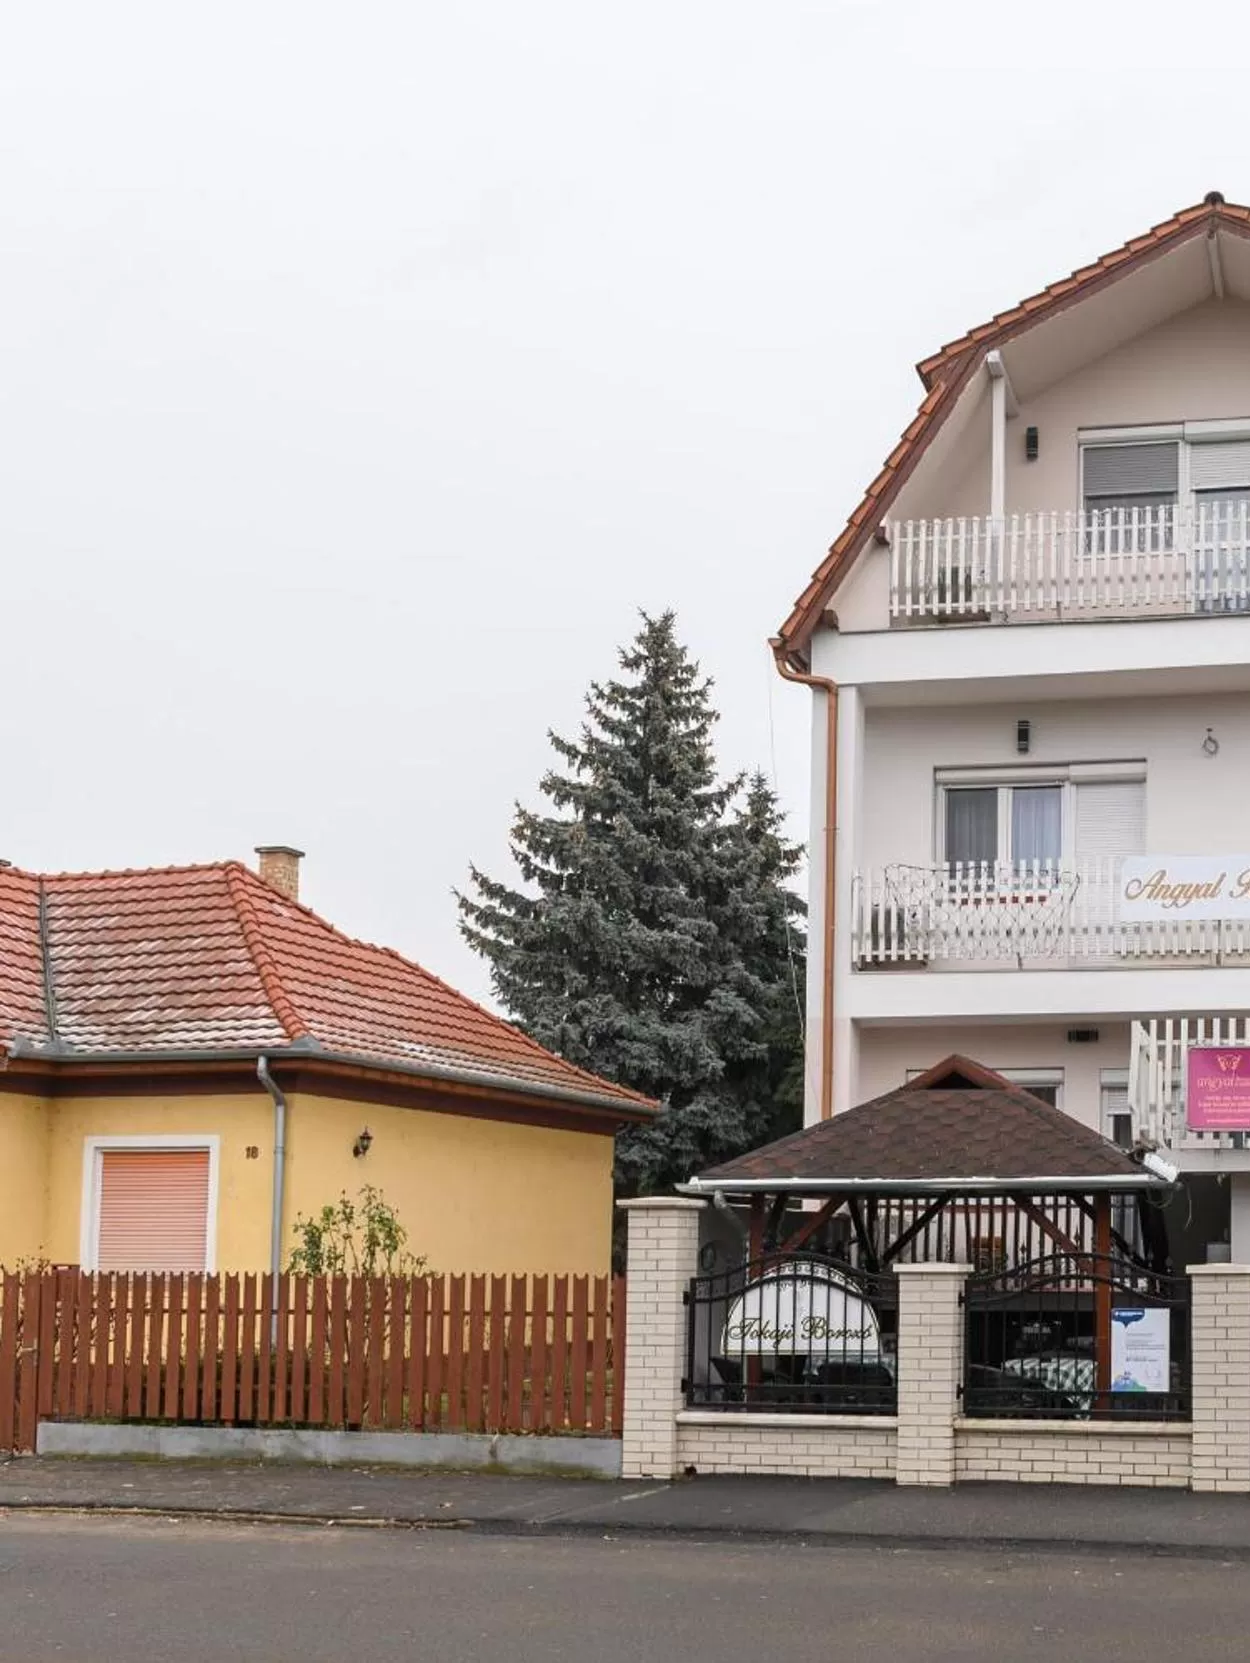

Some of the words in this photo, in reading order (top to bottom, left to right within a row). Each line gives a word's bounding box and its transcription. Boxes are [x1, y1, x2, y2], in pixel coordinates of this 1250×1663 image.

[1125, 869, 1227, 909] Angyal
[245, 1145, 259, 1159] 18
[728, 1317, 794, 1348] Tokaji
